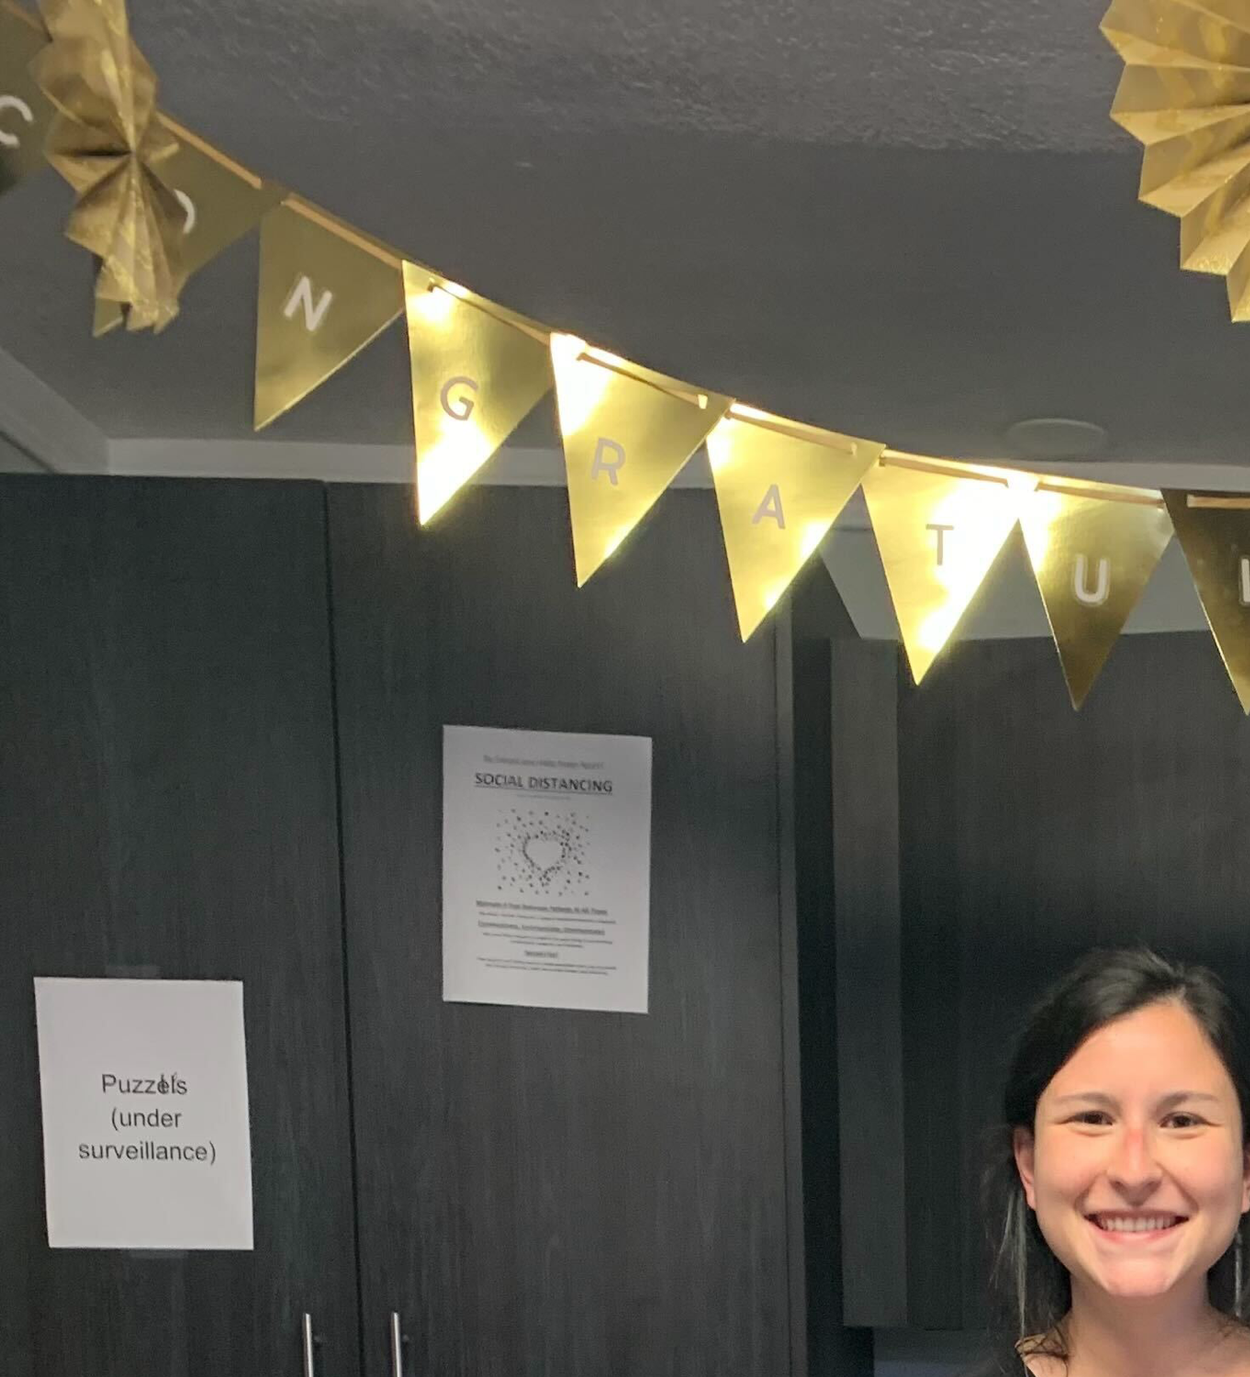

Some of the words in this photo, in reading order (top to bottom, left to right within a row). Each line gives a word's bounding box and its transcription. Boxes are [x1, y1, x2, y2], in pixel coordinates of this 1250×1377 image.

[475, 772, 523, 788] SOCIAL
[528, 775, 613, 793] DISTANCING
[111, 1107, 182, 1132] (under
[78, 1140, 216, 1166] surveillance)
